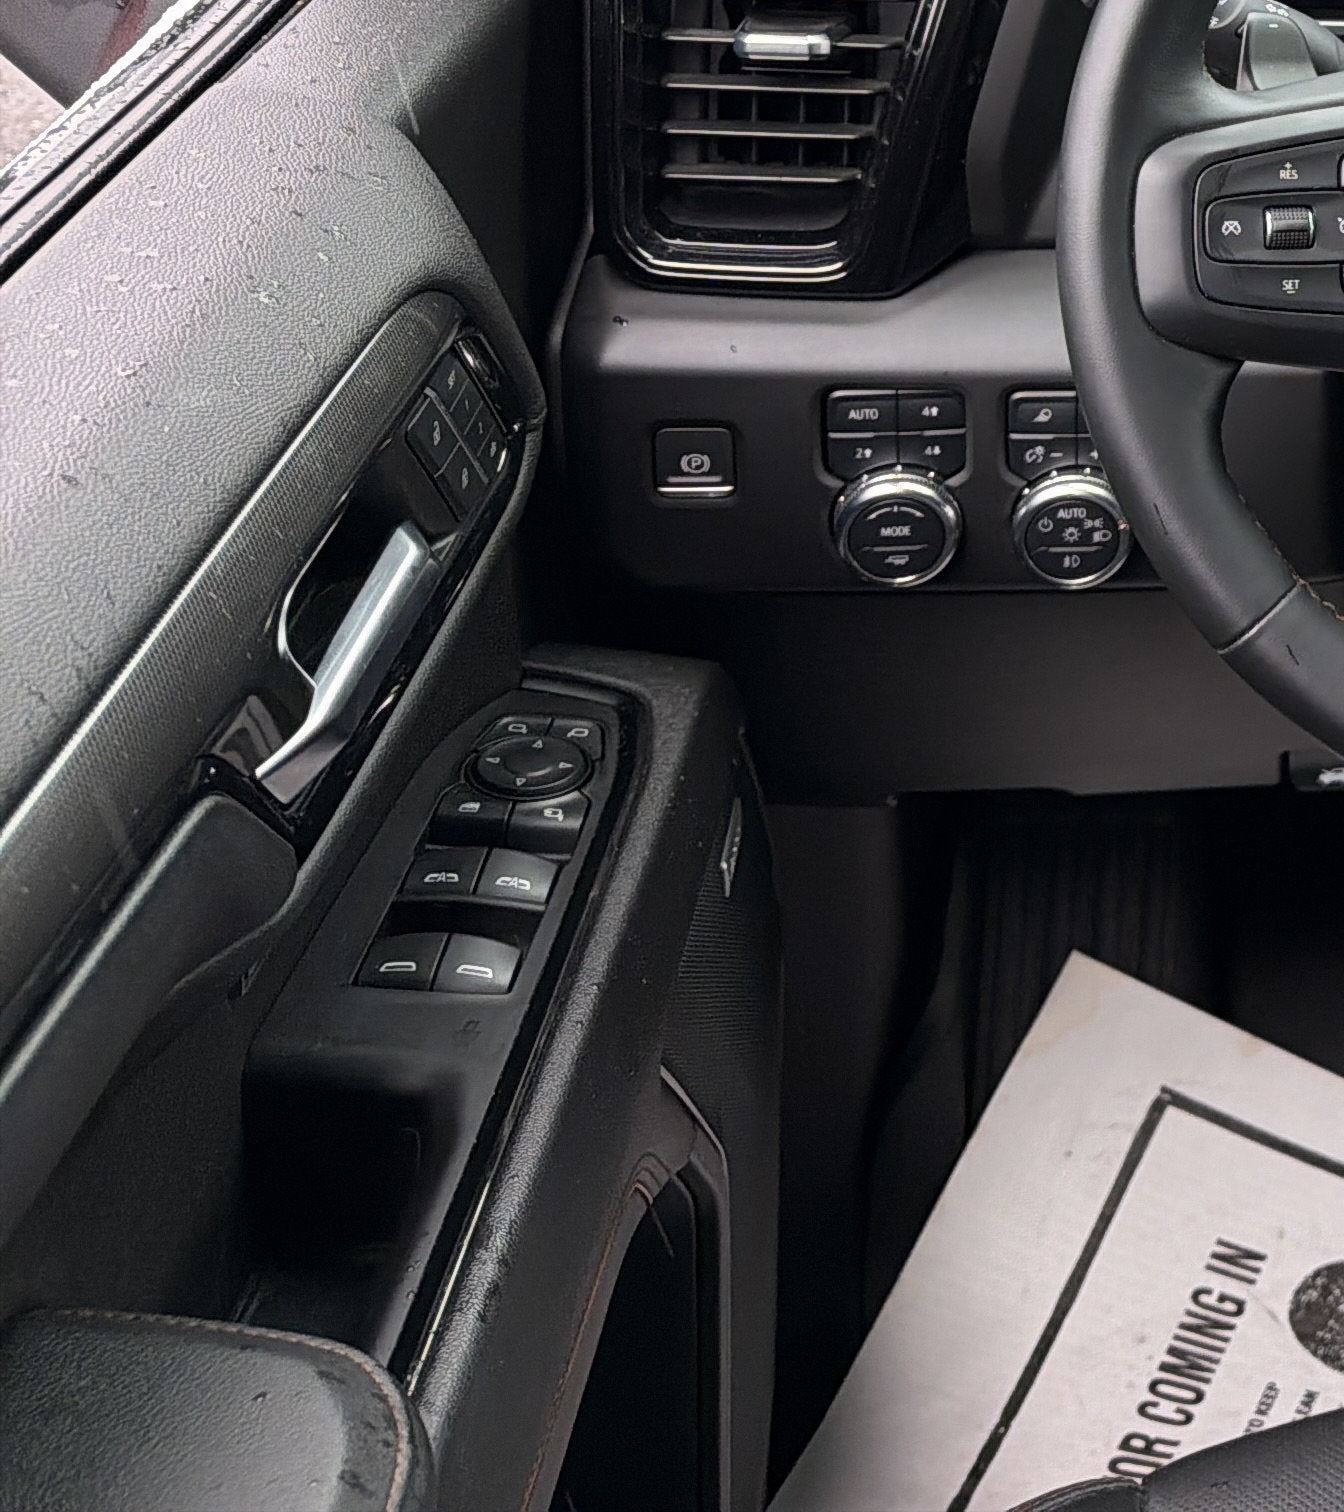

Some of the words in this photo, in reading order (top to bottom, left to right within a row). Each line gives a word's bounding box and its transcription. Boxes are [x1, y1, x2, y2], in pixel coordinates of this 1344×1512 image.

[1280, 170, 1298, 180] RES
[1282, 279, 1300, 290] SET
[848, 408, 879, 421] AUTO
[1057, 508, 1086, 519] AUTO
[880, 525, 912, 536] MODE
[1204, 1237, 1268, 1286] IN
[1137, 1287, 1247, 1427] COMING
[1254, 1381, 1280, 1417] KEEP
[1108, 1431, 1182, 1480] OR
